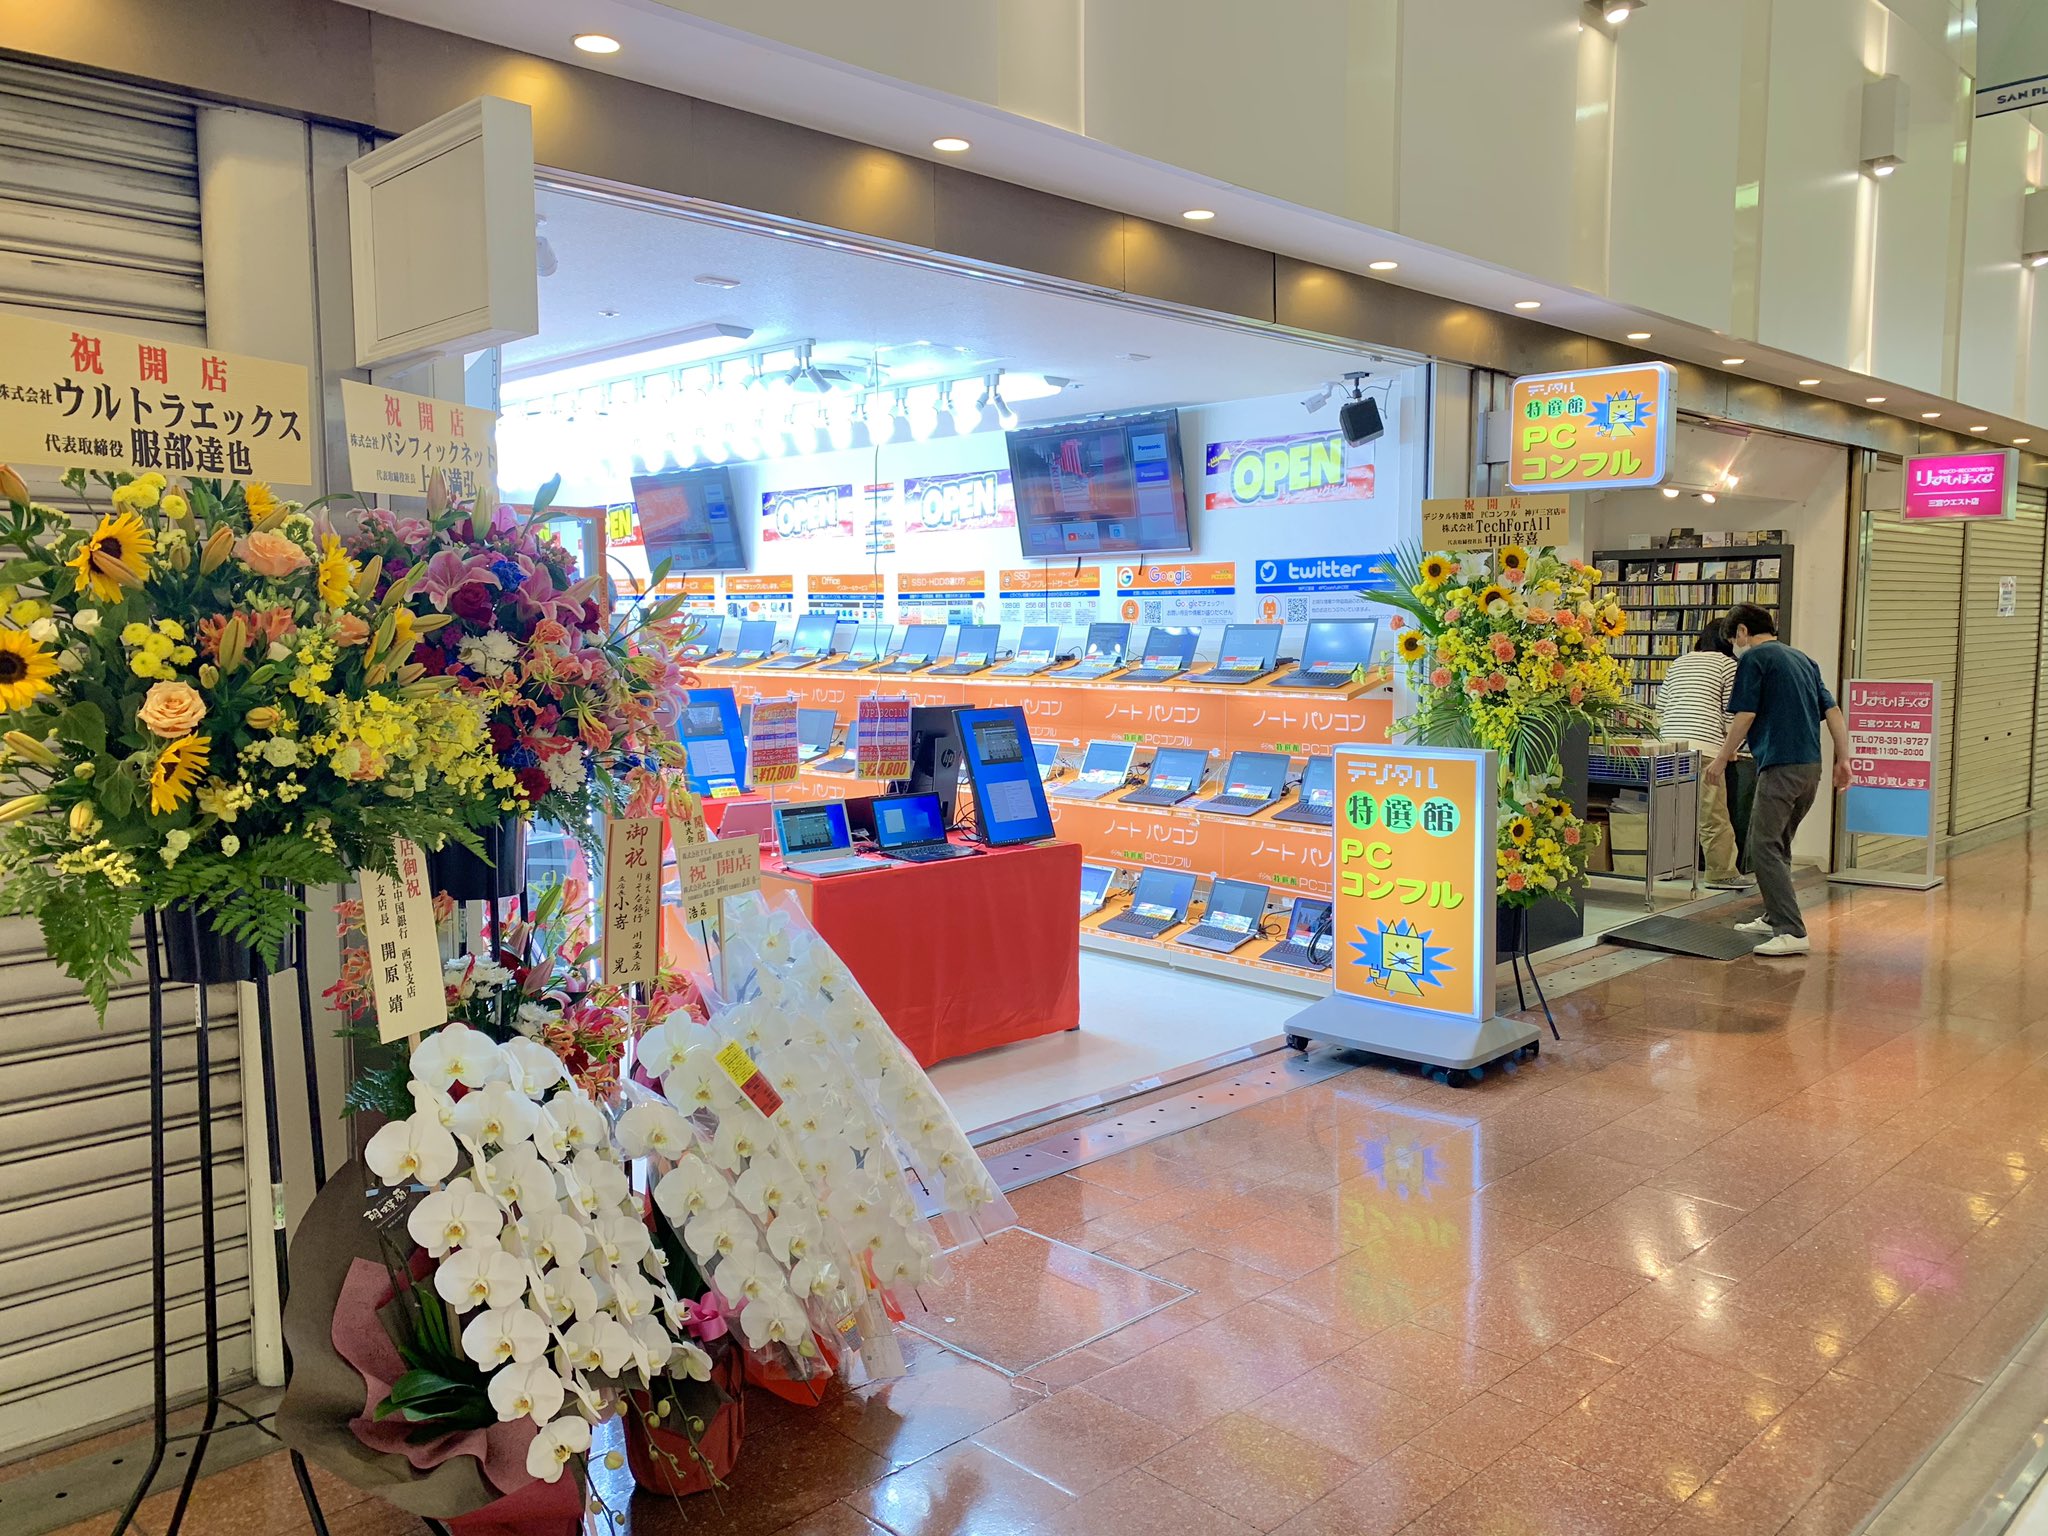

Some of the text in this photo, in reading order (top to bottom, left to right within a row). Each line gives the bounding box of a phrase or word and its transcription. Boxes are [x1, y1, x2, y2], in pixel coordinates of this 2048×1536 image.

[1997, 91, 2028, 104] SAN
[1527, 382, 1575, 396] デジタル
[1526, 396, 1584, 418] 特選館
[1523, 424, 1577, 452] PC
[45, 428, 253, 475] 代表取締役 服部達也
[1234, 438, 1342, 499] OPEN
[1522, 449, 1643, 480] コンフル
[418, 464, 477, 497] 上満弘
[922, 477, 996, 527] OPEN
[1928, 498, 1979, 507] 三宮ウエスト店
[1423, 511, 1474, 520] デジタル特選館
[1481, 510, 1517, 518] PCコンフル
[1485, 532, 1538, 547] 中山幸喜
[1013, 571, 1031, 581] SSD
[1149, 566, 1192, 586] Google
[1288, 560, 1362, 579] twitter
[812, 689, 845, 702] パソコン
[1105, 704, 1200, 723] ノート パソコン
[1253, 710, 1366, 732] ノート パソコン
[1858, 719, 1921, 729] 三宮ウエスト店
[1145, 734, 1193, 747] PCコンフル
[1851, 735, 1929, 746] TEL:078-391-9727
[759, 764, 797, 782] ¥17,800
[865, 762, 908, 776] ¥24,800
[1347, 761, 1439, 789] デジタル
[1851, 760, 1875, 771] CD
[1348, 794, 1453, 832] 特選館
[684, 821, 694, 844] 株式会
[1104, 820, 1198, 845] ノート パソコン
[625, 823, 649, 868] 御祝
[1250, 840, 1295, 861] ノート
[1341, 837, 1393, 869] PC
[1145, 852, 1192, 868] PCコンフル
[1341, 870, 1464, 909] コンフル
[376, 884, 390, 926] 支店長
[631, 931, 642, 972] 川西支店
[401, 947, 416, 999] 西宮支店
[612, 957, 628, 974] 晃
[380, 941, 404, 1014] 開原 靖
